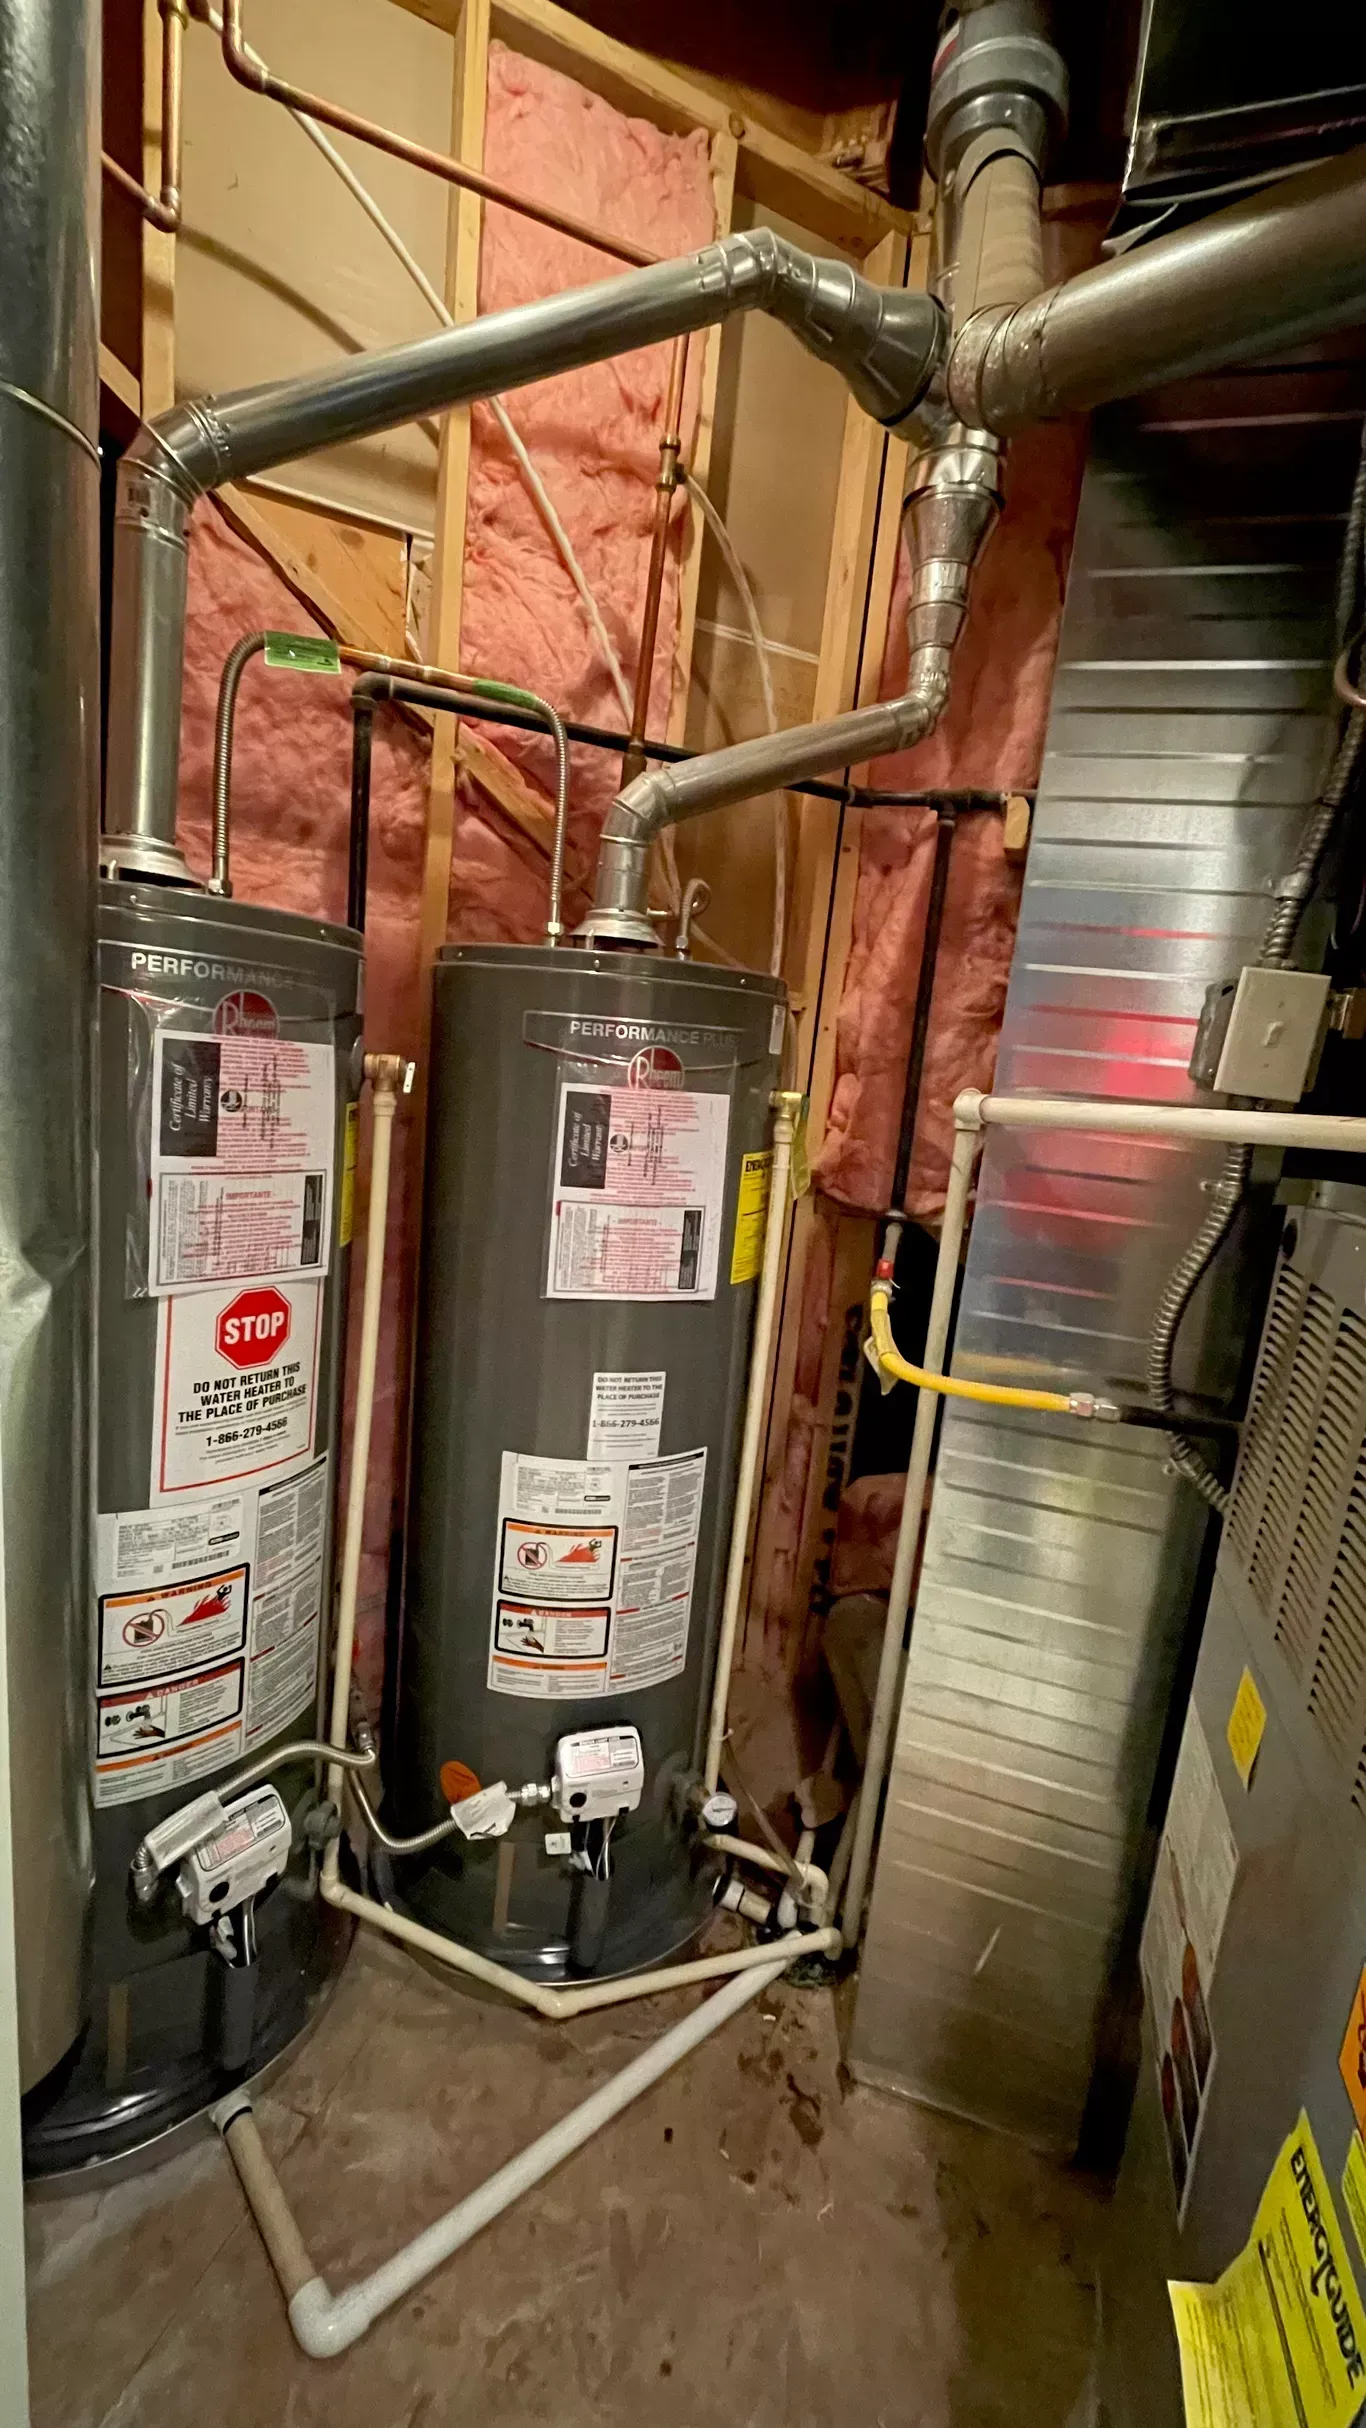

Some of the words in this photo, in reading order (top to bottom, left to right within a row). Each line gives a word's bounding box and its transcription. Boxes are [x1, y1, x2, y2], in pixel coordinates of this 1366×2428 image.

[570, 1020, 700, 1044] PERFORMANCE
[170, 1061, 186, 1076] of
[169, 1076, 184, 1131] Certificate
[184, 1077, 197, 1119] Limited
[198, 1076, 213, 1122] Warranty
[224, 1311, 285, 1345] STOP
[193, 1381, 210, 1394] DO
[214, 1377, 237, 1391] NOT
[239, 1367, 280, 1387] RETURN
[282, 1361, 301, 1377] THIS
[200, 1390, 241, 1406] WATER
[243, 1380, 282, 1399] HEATER
[284, 1376, 295, 1388] TO
[178, 1409, 202, 1423] THE
[206, 1402, 243, 1419] PLACE
[246, 1399, 259, 1411] OF
[262, 1383, 307, 1408] PURCHASE
[161, 1581, 213, 1600] WARNING
[156, 1678, 200, 1697] DANGER
